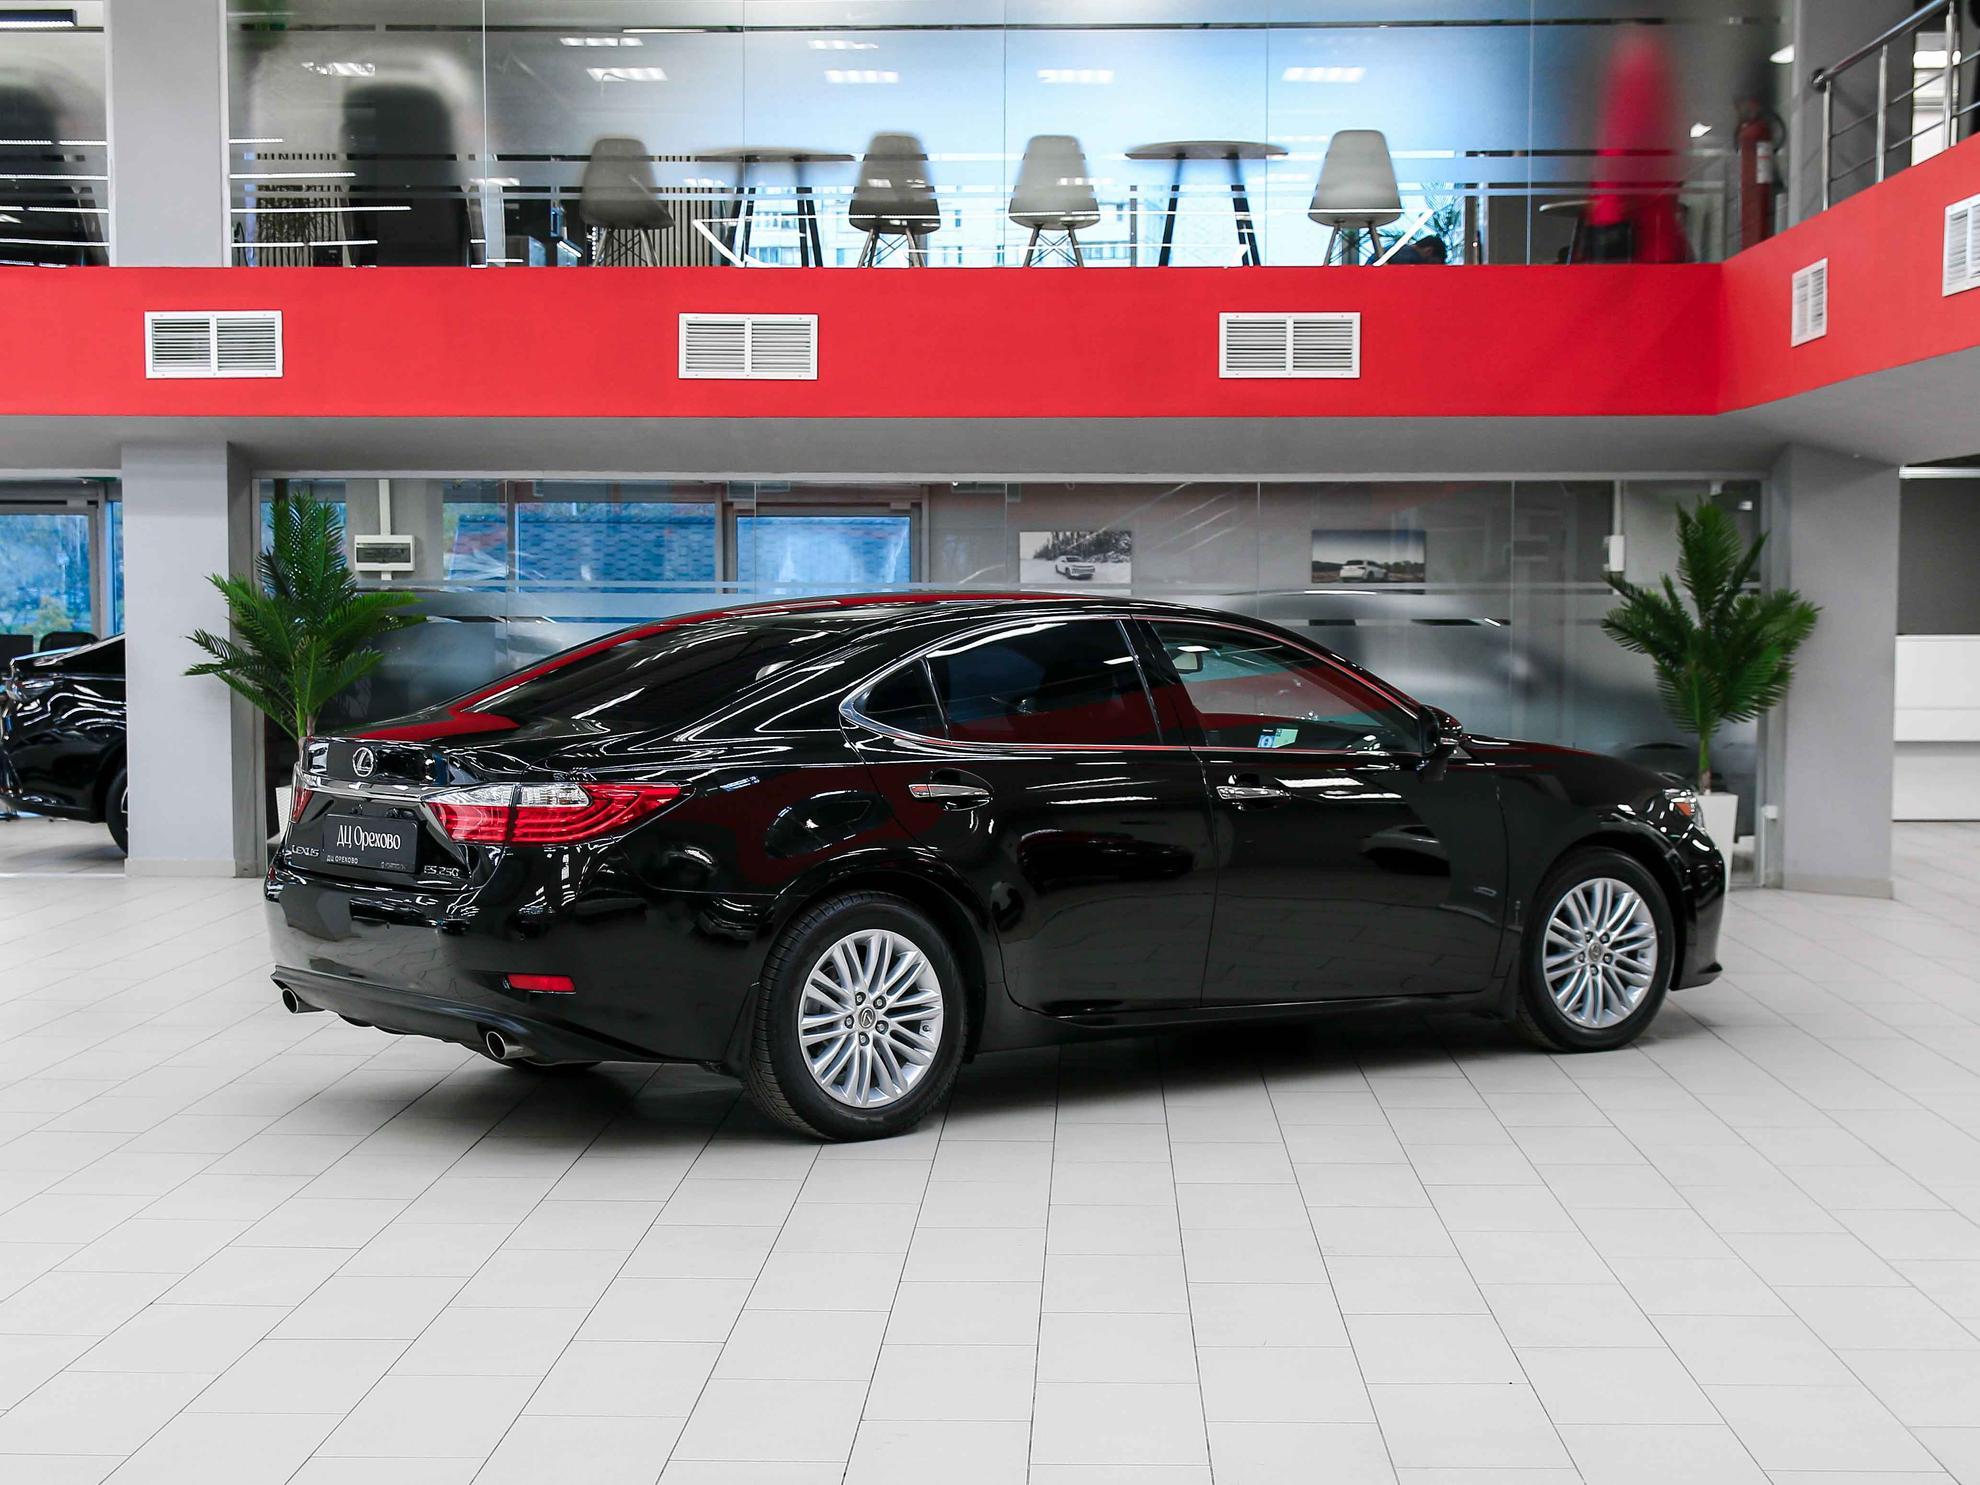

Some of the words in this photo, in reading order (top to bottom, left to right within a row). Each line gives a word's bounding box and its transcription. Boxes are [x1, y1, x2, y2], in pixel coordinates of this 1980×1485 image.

[336, 824, 352, 849] ДЦ
[353, 825, 401, 851] Орехово
[291, 844, 320, 857] LEXUS
[423, 865, 437, 875] ES
